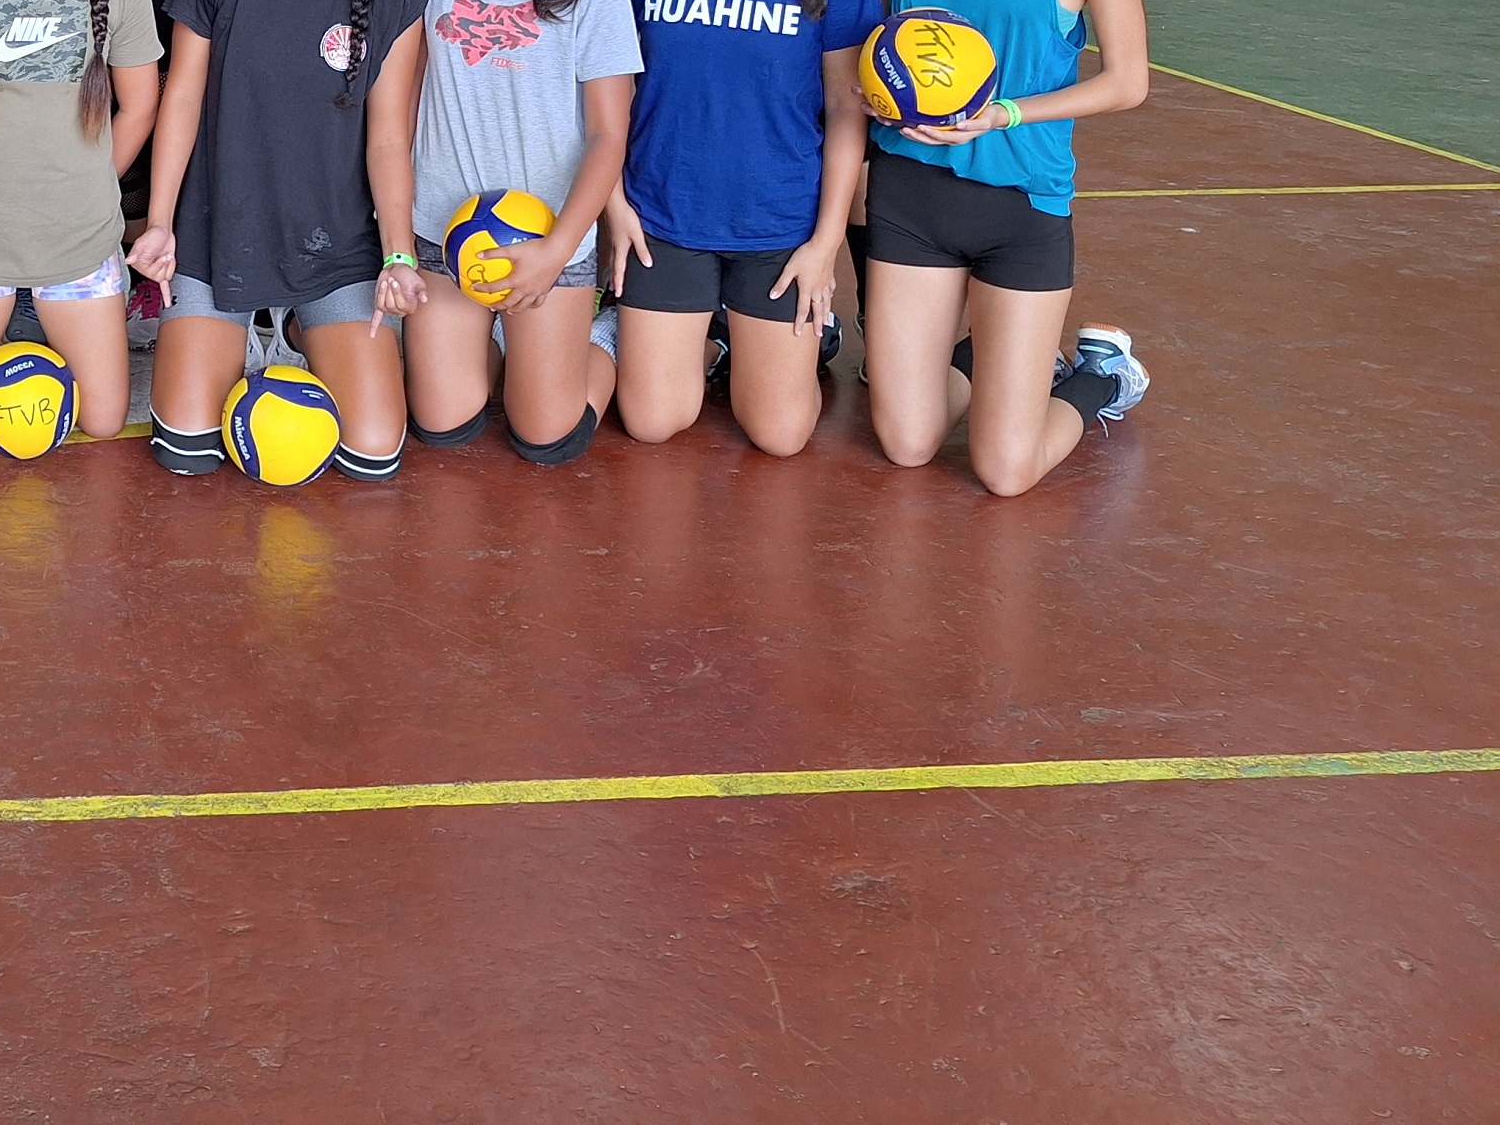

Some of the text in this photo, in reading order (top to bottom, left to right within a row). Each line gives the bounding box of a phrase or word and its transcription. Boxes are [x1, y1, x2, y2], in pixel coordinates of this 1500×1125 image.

[6, 17, 62, 42] NIKE
[879, 46, 907, 90] MIKASA
[234, 416, 251, 461] MIKASA
